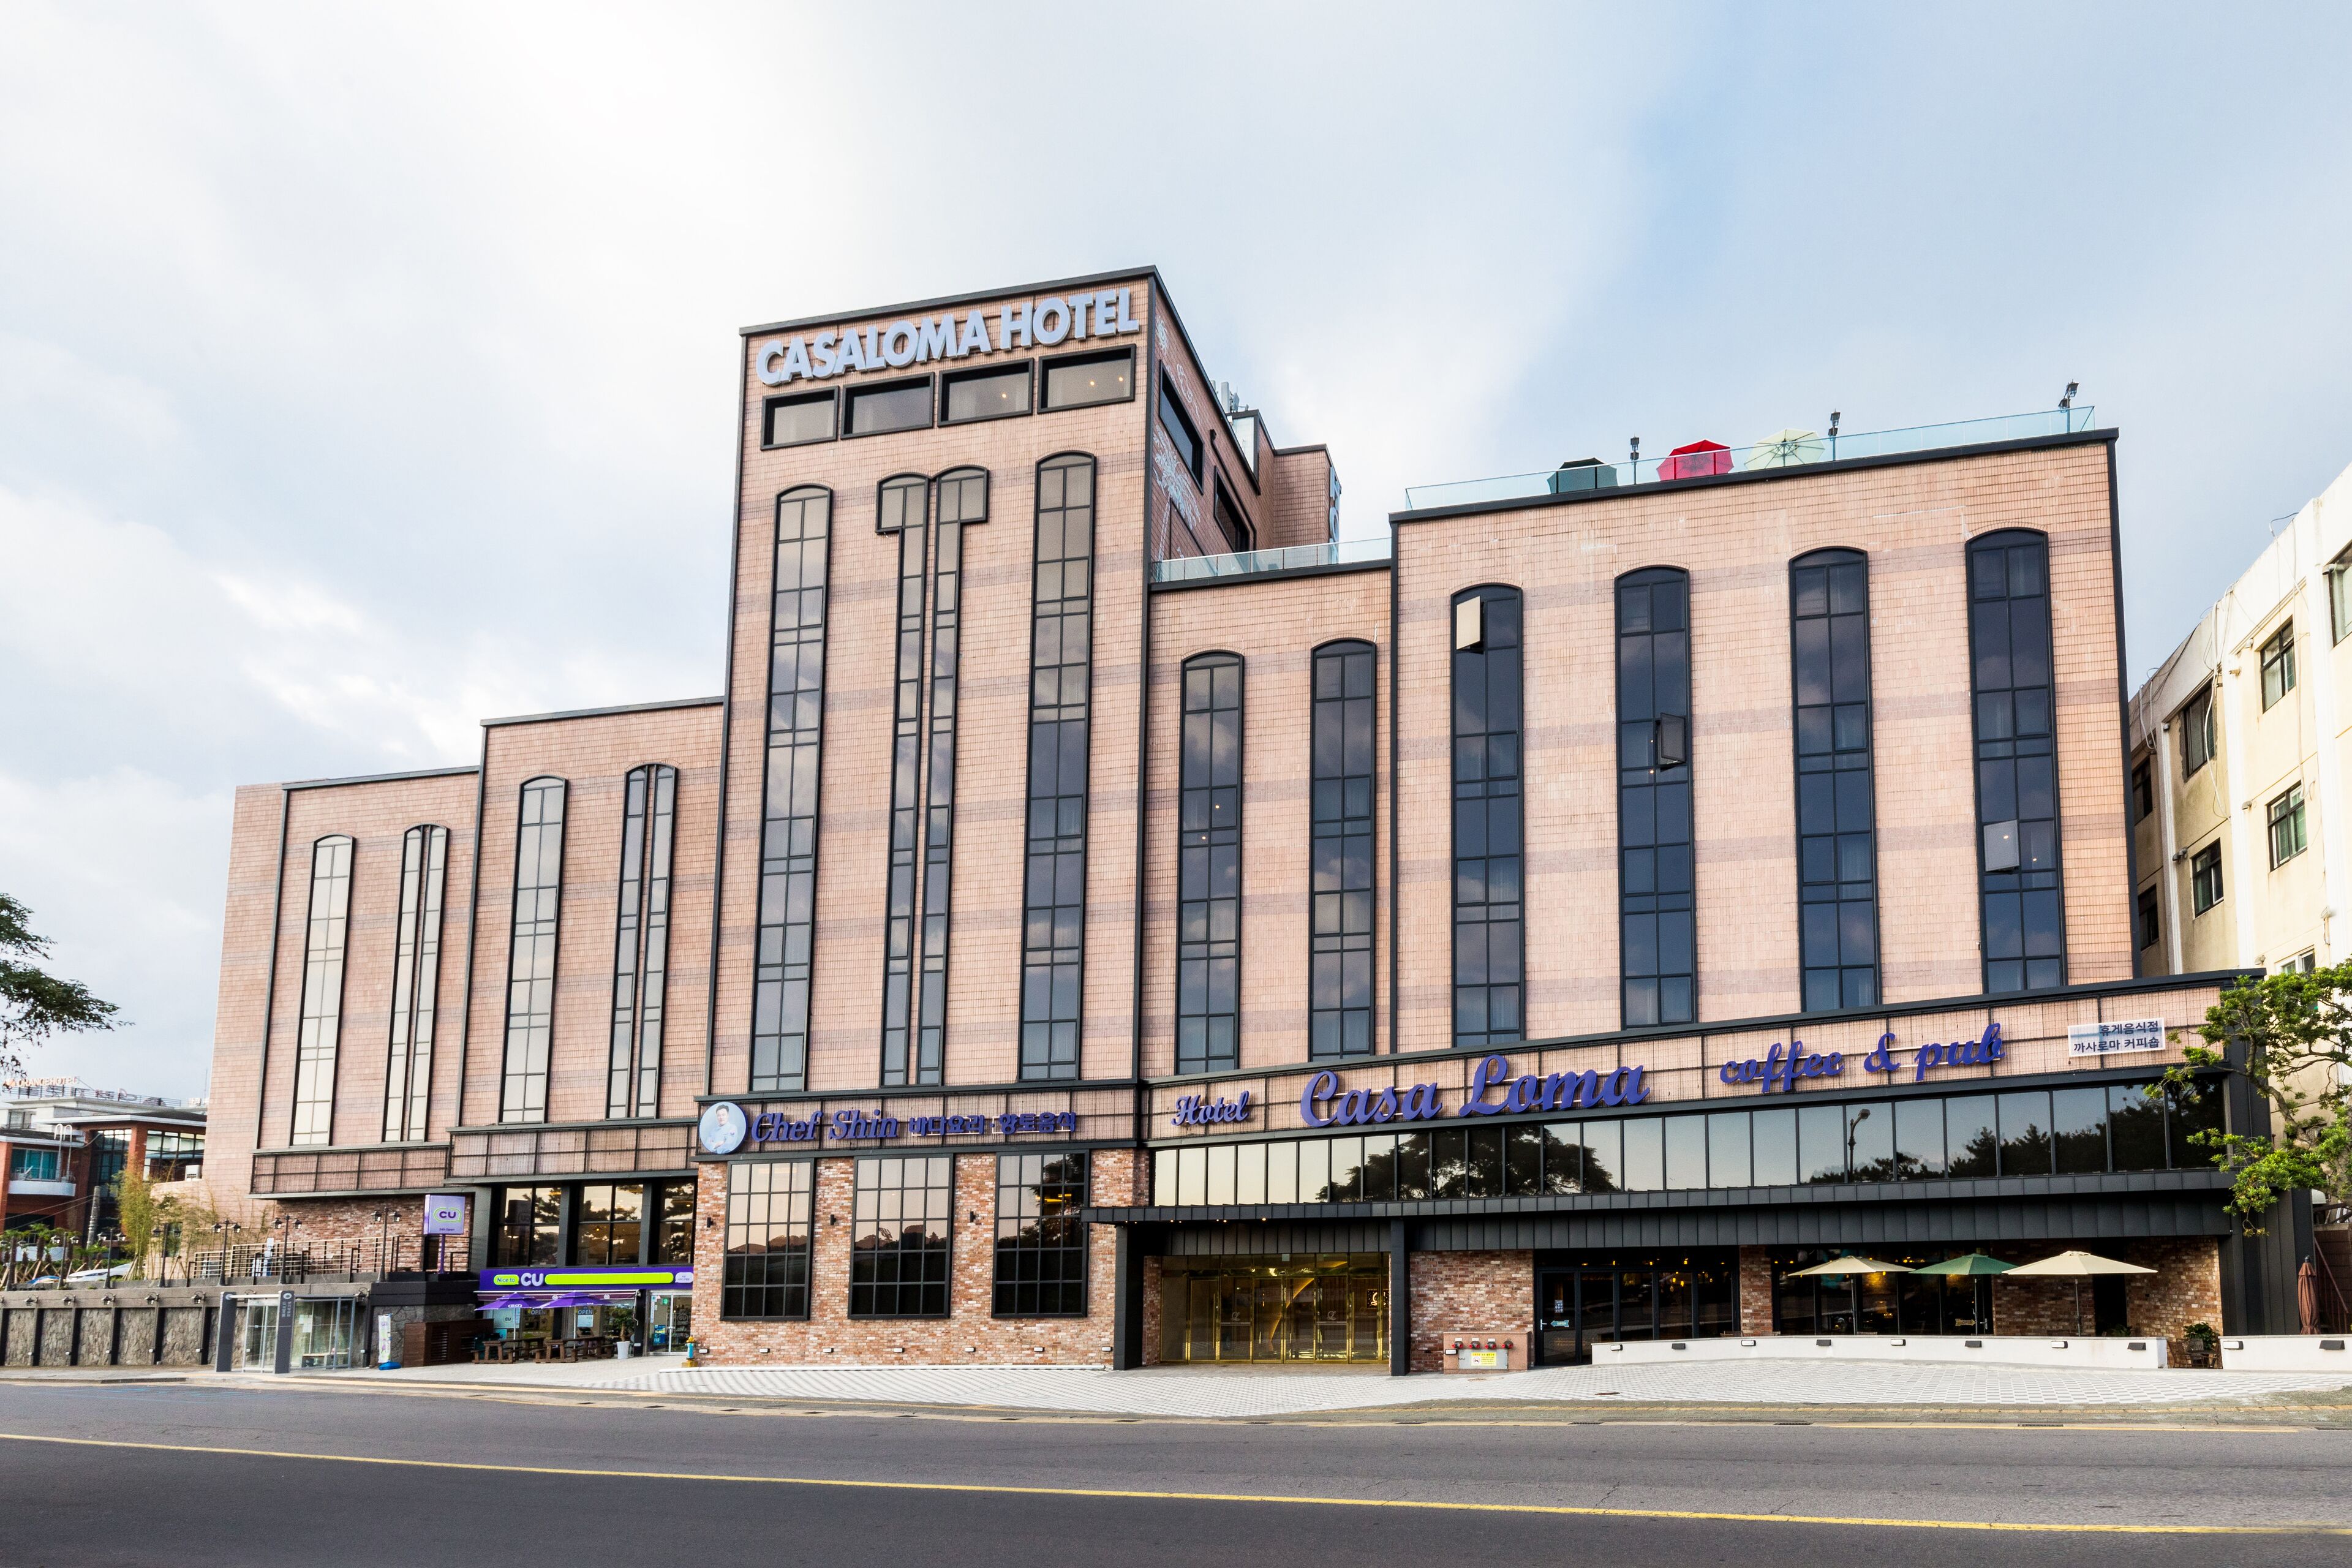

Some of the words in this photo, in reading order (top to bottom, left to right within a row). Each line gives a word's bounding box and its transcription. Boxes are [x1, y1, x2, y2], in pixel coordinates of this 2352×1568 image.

[756, 309, 992, 386] CASALOMA
[1000, 288, 1140, 350] HOTEL
[2074, 1039, 2120, 1053] 까사로마
[2124, 1036, 2160, 1049] 커피숍
[2100, 1020, 2159, 1037] 휴게음식점
[1720, 1040, 1845, 1093] coffee
[1864, 1032, 1901, 1072] &
[1914, 1022, 2006, 1082] pub
[1171, 1090, 1250, 1126] Hotel
[1300, 1070, 1443, 1128] Casa
[1459, 1055, 1651, 1117] Loma
[751, 1110, 824, 1142] Chef
[829, 1109, 899, 1140] Shin
[909, 1114, 985, 1136] 바다요리
[521, 1272, 544, 1286] CU
